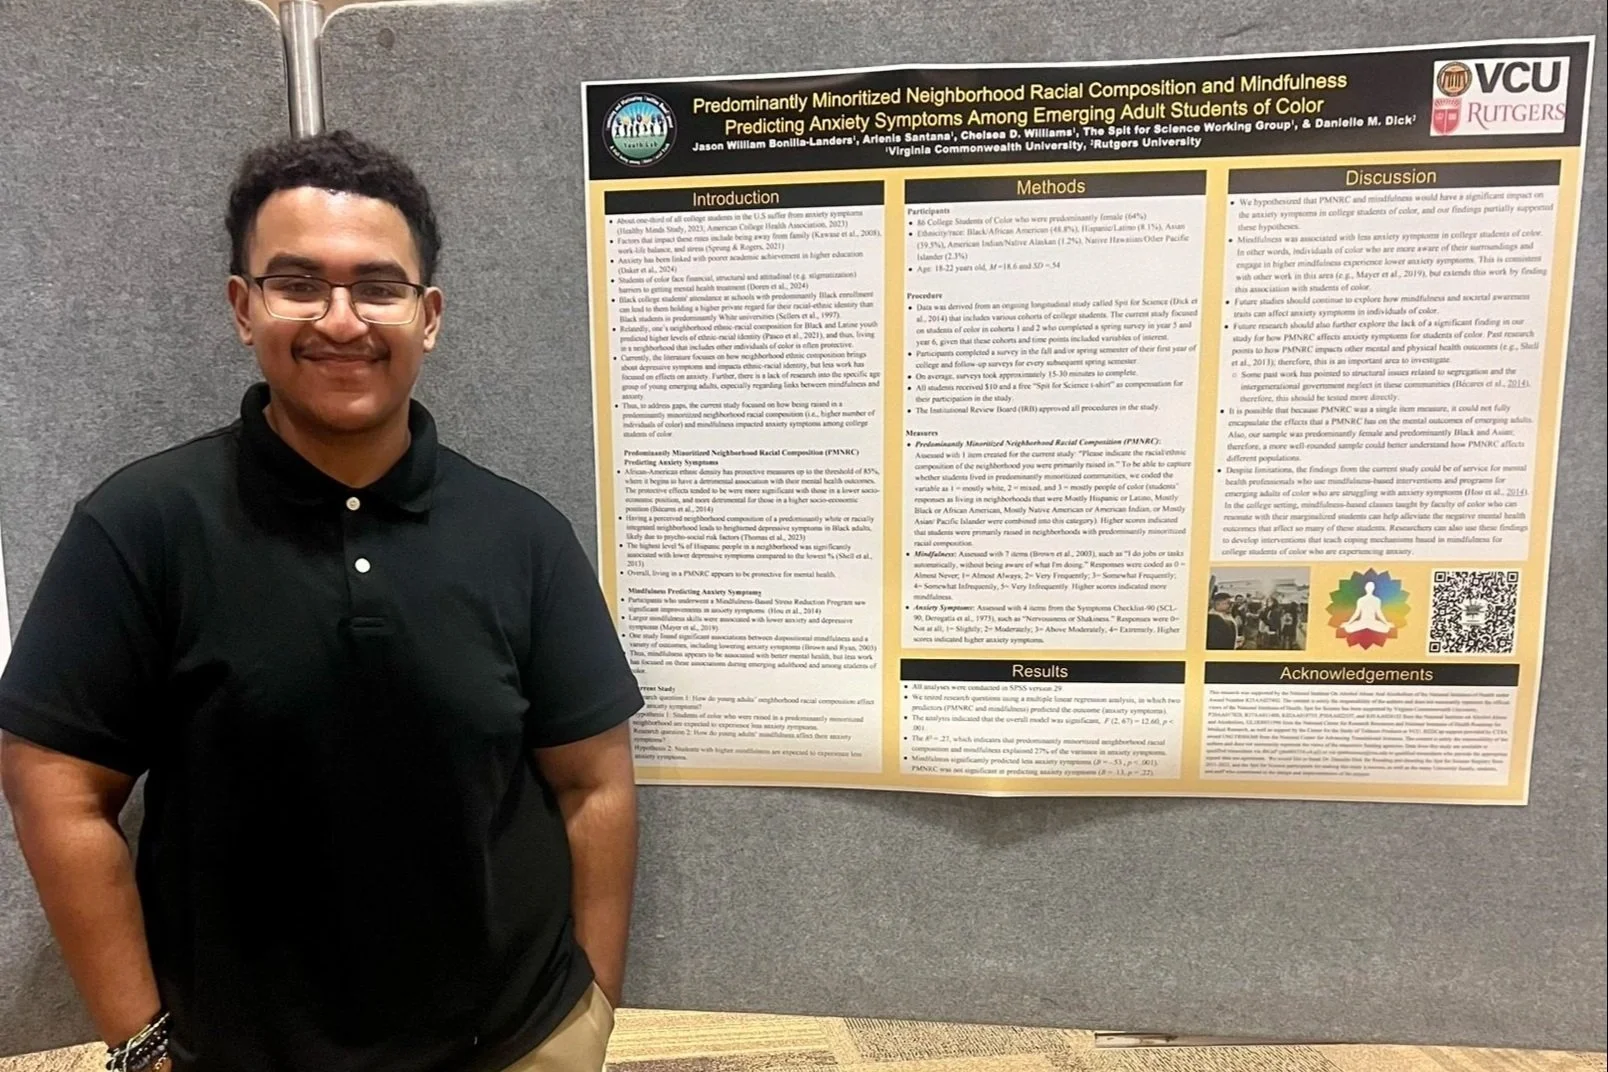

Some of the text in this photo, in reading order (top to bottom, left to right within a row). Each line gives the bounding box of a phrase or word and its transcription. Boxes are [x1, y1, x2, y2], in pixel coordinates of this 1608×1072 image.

[1475, 61, 1562, 94] VCU
[693, 92, 807, 118] Predominantly
[812, 87, 900, 108] Minoritized
[906, 83, 1024, 107] Neighborhood
[1030, 82, 1083, 100] Racial
[1088, 78, 1196, 101] Composition
[1201, 76, 1234, 93] and
[1240, 71, 1348, 92] Mindfulness
[725, 95, 1325, 139] Predicting Anxiety Symptoms Among Emerging Adult Students of Color
[1468, 102, 1567, 130] RUTGERS
[692, 140, 723, 151] Jason
[726, 138, 765, 150] William
[862, 132, 901, 144] Arlenis
[960, 128, 1005, 140] Chelsea
[1009, 128, 1020, 139] D.
[1083, 125, 1104, 136] The
[1107, 124, 1130, 137] Spit
[1134, 124, 1150, 134] for
[1153, 122, 1200, 134] Science
[1203, 120, 1251, 134] Working
[1302, 118, 1310, 128] &
[1314, 116, 1363, 128] Danielle
[1367, 115, 1381, 126] M.
[934, 140, 1021, 154] Commonwealth
[1025, 139, 1086, 153] University,
[1142, 135, 1202, 149] University
[1017, 179, 1086, 195] Methods
[1345, 169, 1437, 187] Discussion
[693, 190, 779, 207] Introduction
[907, 206, 951, 217] Participants
[1233, 321, 1256, 330] Future
[1258, 321, 1288, 329] research
[1289, 320, 1314, 329] should
[1315, 320, 1330, 328] also
[1332, 320, 1356, 328] further
[1358, 319, 1385, 329] explore
[1387, 319, 1398, 327] the
[1400, 319, 1415, 327] lack
[1433, 317, 1472, 328] significant
[1474, 317, 1500, 327] finding
[1012, 664, 1069, 679] Results
[1280, 666, 1433, 683] Acknowledgements
